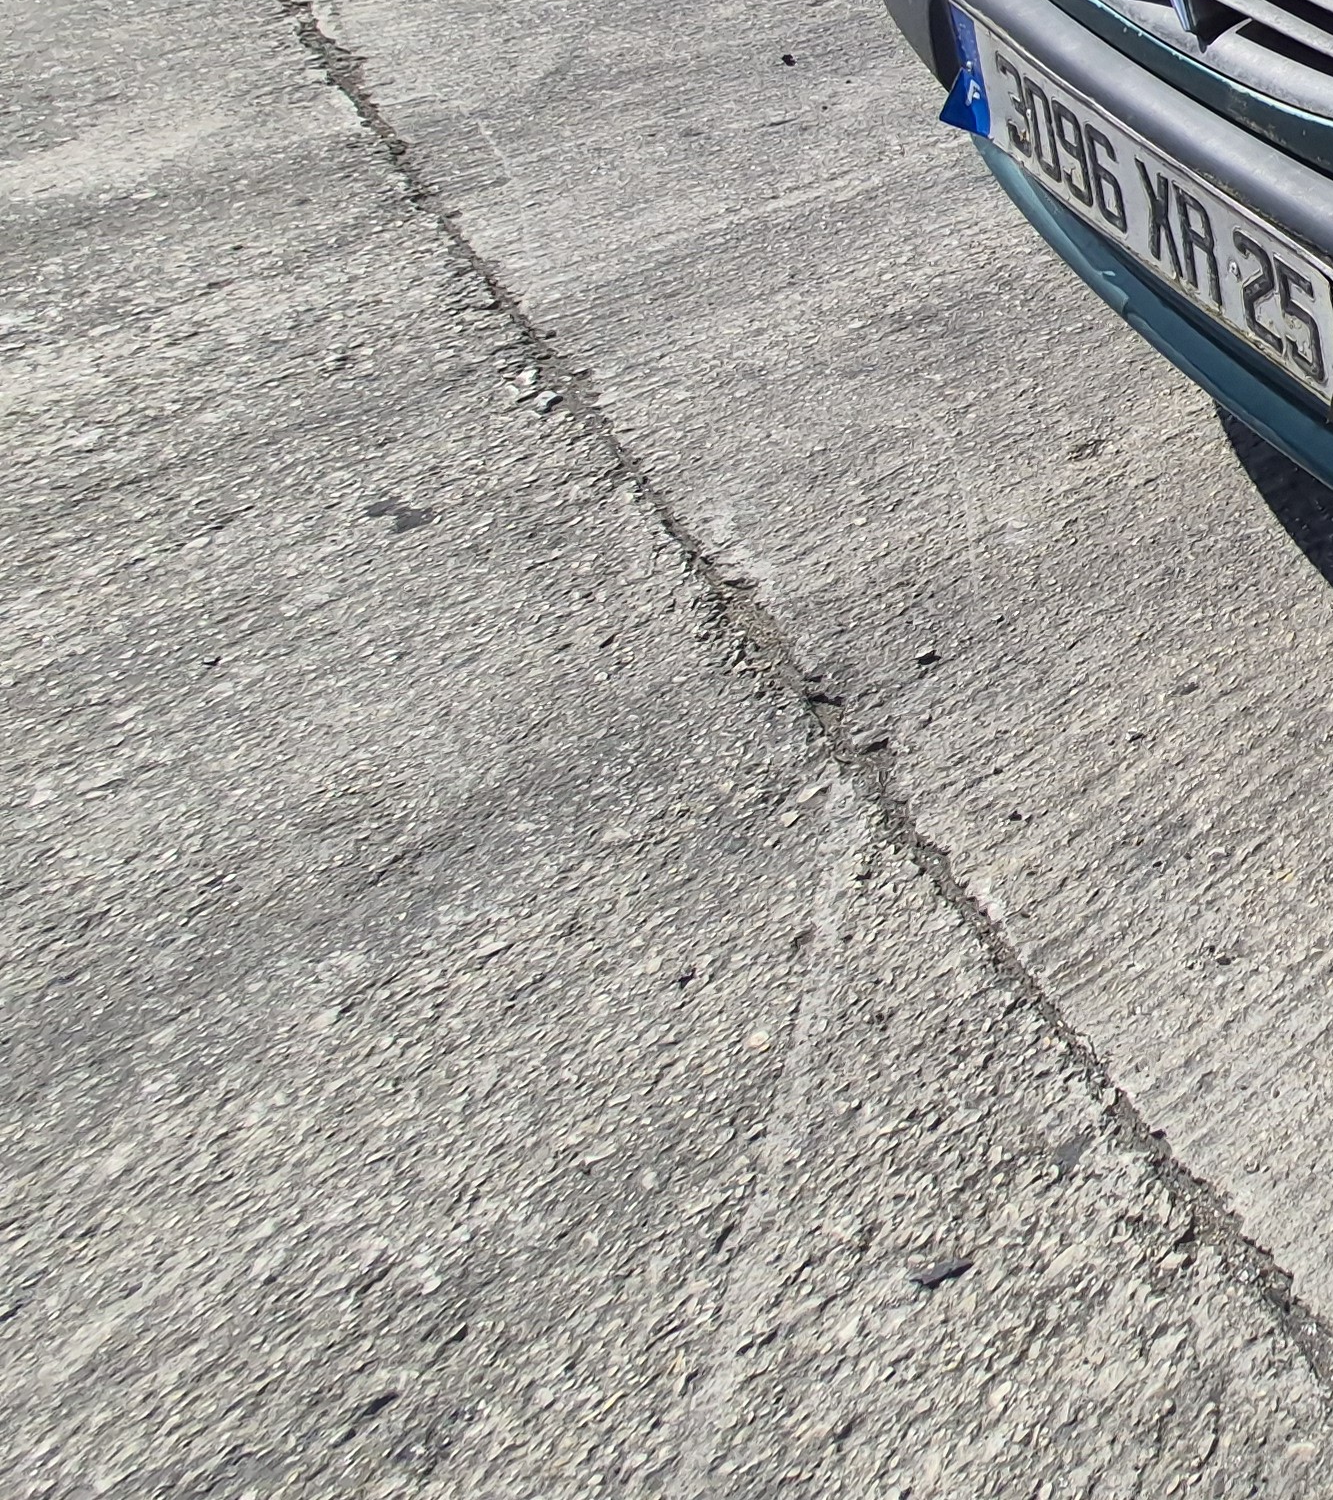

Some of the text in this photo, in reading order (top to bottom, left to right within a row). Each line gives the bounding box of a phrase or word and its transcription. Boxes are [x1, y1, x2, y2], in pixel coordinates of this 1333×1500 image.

[995, 50, 1326, 383] 3096 XR 25
